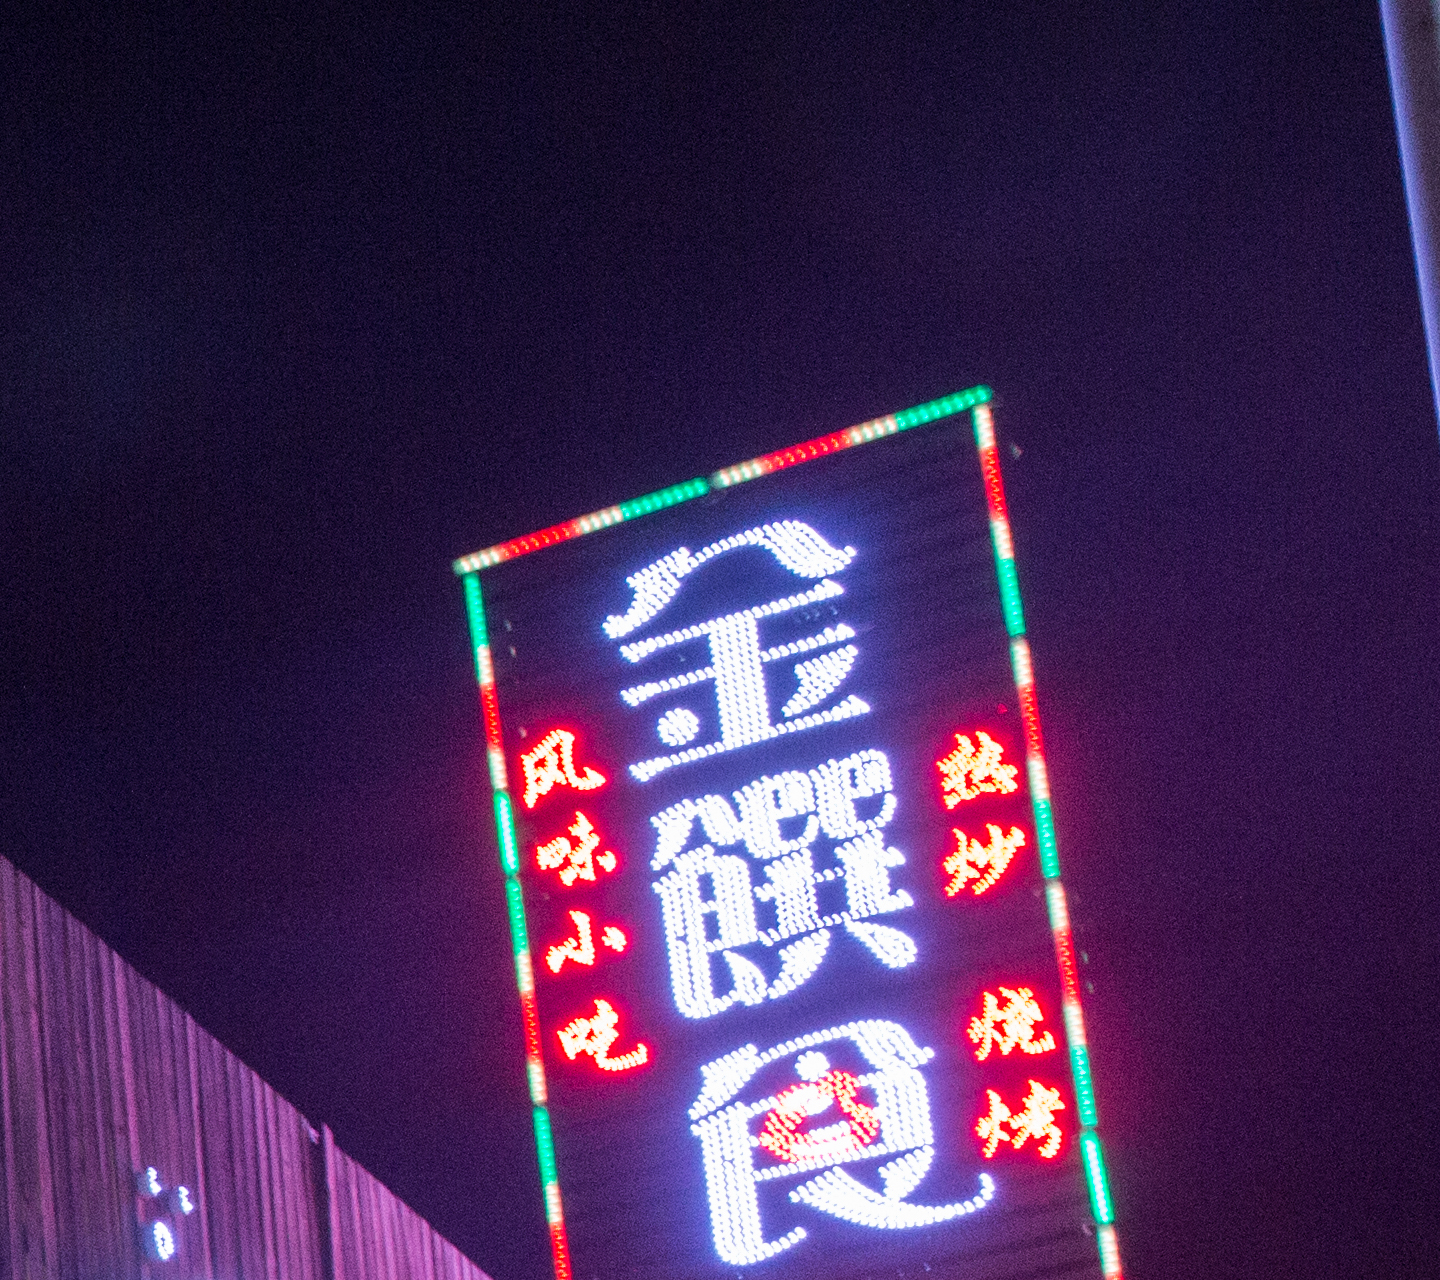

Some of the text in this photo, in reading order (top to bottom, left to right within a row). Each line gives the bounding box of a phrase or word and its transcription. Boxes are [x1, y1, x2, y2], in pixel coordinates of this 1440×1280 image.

[520, 728, 649, 1073] 风味小吃
[966, 985, 1066, 1159] 烧烤
